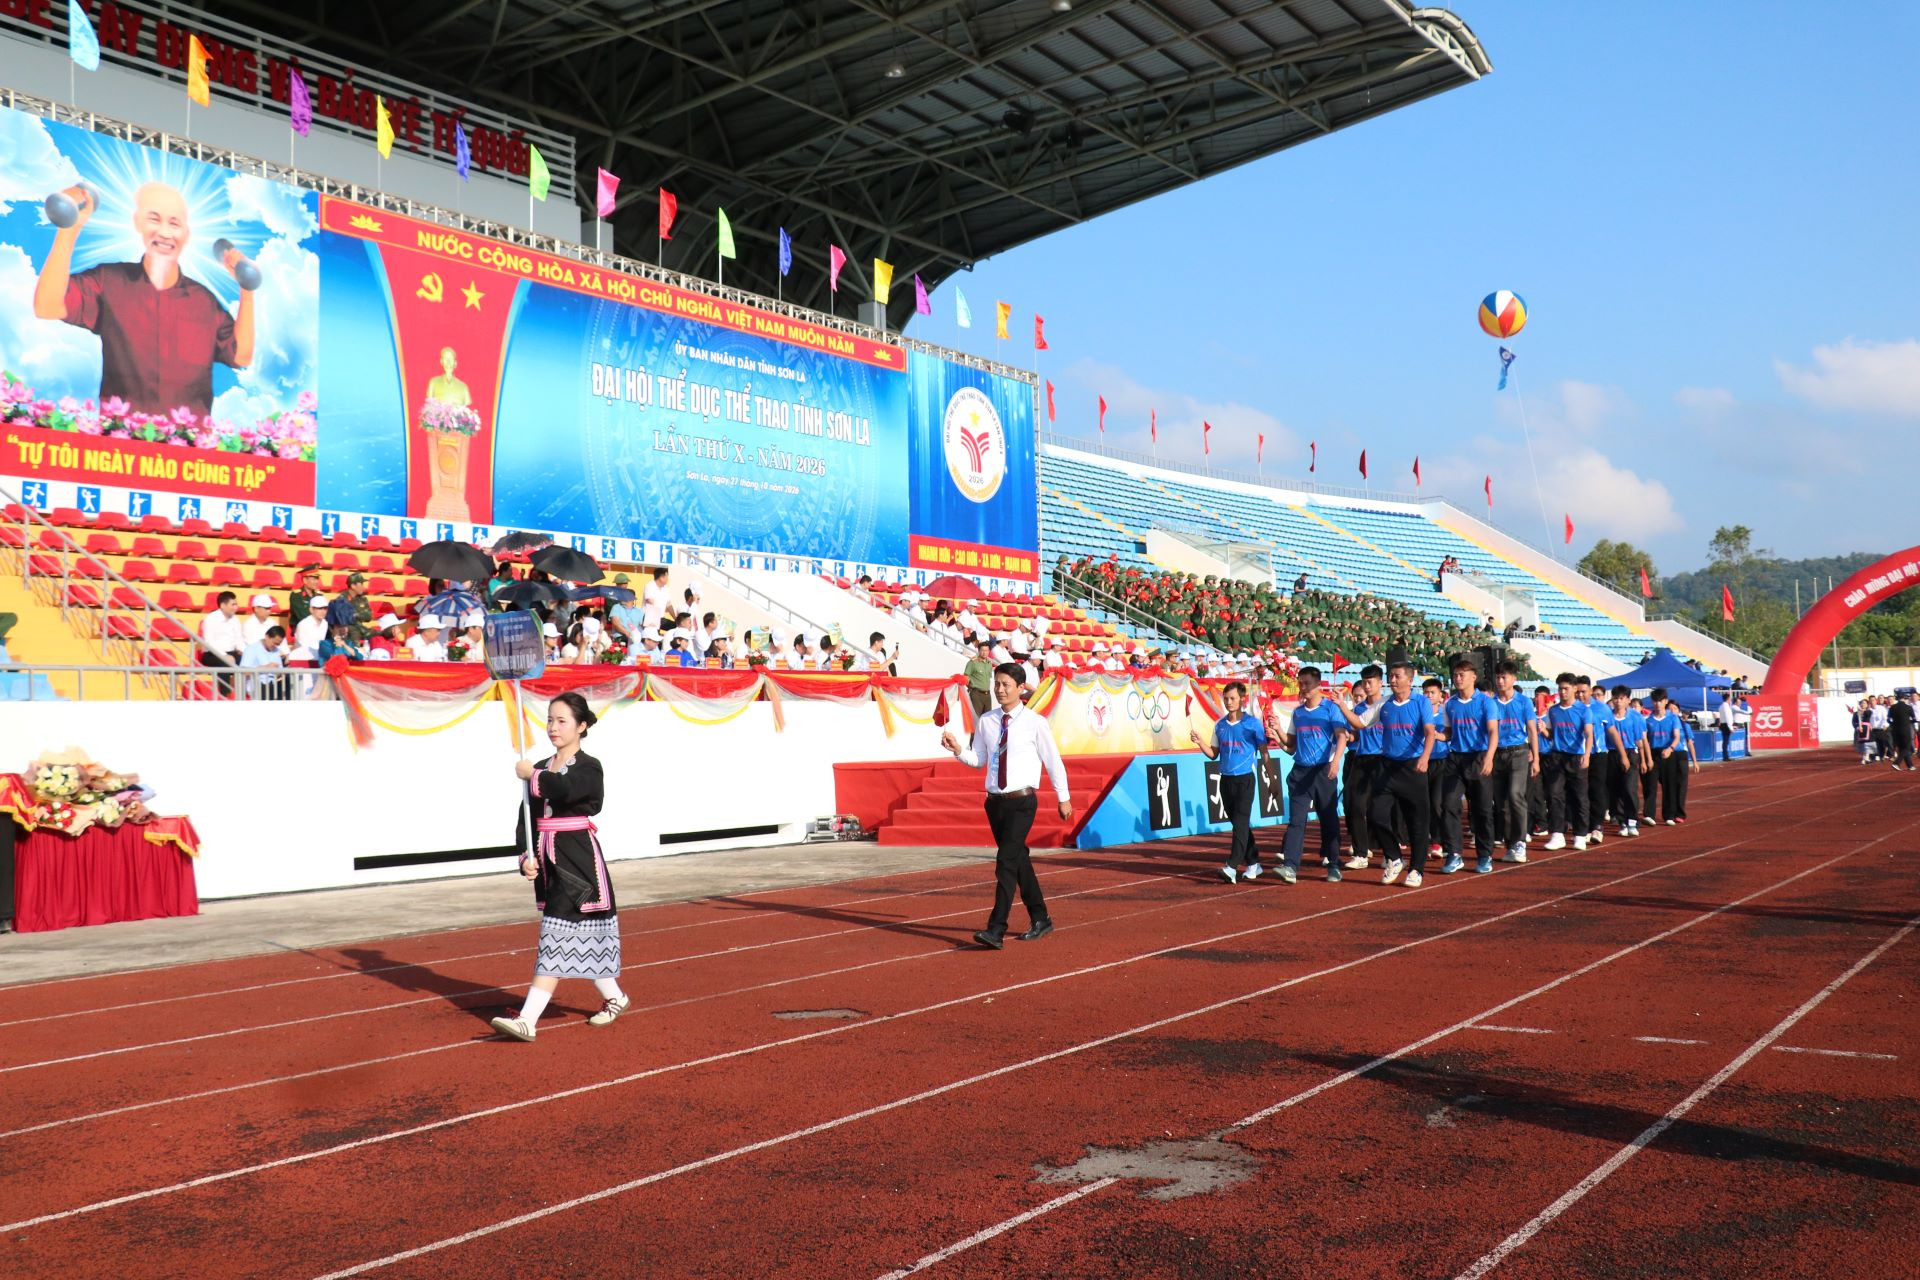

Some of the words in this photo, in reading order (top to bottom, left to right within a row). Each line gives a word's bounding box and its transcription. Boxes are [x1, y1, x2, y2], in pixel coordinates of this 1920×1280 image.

[317, 67, 378, 130] BẢO
[417, 231, 473, 259] NƯỚC
[478, 247, 533, 274] CỘNG
[538, 261, 575, 285] HÒA
[579, 272, 603, 292] XÃ
[607, 279, 636, 302] HỘI
[640, 289, 673, 309] CHỦ
[676, 297, 722, 321] NGHĨA
[726, 309, 753, 330] VIỆT
[755, 318, 785, 337] NAM
[788, 326, 825, 347] MUÔN
[828, 335, 855, 355] NĂM
[675, 340, 690, 356] ỦY
[689, 346, 709, 361] BAN
[710, 351, 736, 367] NHÂN
[737, 356, 756, 372] DÂN
[757, 359, 777, 376] TỈNH
[777, 367, 795, 380] SƠN
[796, 371, 806, 383] LA
[592, 362, 621, 406] ĐẠI
[625, 365, 653, 412] HỘI
[657, 368, 686, 412] THỂ
[690, 382, 720, 423] DỤC
[724, 382, 751, 424] THỂ
[754, 395, 789, 431] THAO
[792, 394, 823, 437] TỈNH
[826, 410, 853, 443] SƠN
[855, 416, 871, 447] LA
[7, 434, 46, 469] “TỰ
[48, 442, 79, 469] TÔI
[84, 448, 135, 475] NGÀY
[139, 453, 178, 480] NÀO
[182, 459, 230, 486] CŨNG
[234, 464, 276, 492] TẬP”
[652, 422, 690, 455] LẦN
[693, 435, 731, 461] THỨ
[733, 443, 745, 464] X
[757, 444, 793, 472] NĂM
[796, 455, 826, 477] 2026
[730, 476, 739, 486] 27
[739, 478, 759, 491] tháng
[760, 481, 768, 490] 10
[784, 485, 799, 495] 2026
[918, 544, 938, 562] NHANH
[938, 546, 951, 564] HƠN
[954, 549, 966, 565] CAO
[966, 550, 978, 567] HƠN
[989, 553, 1001, 570] HƠN
[1004, 555, 1020, 575] MẠNH
[1020, 558, 1032, 574] HƠN
[1843, 588, 1867, 608] CHÀO
[1864, 575, 1891, 595] MỪNG
[1887, 568, 1905, 583] ĐẠI
[1902, 561, 1919, 577] HỘI
[1755, 712, 1783, 729] 5G
